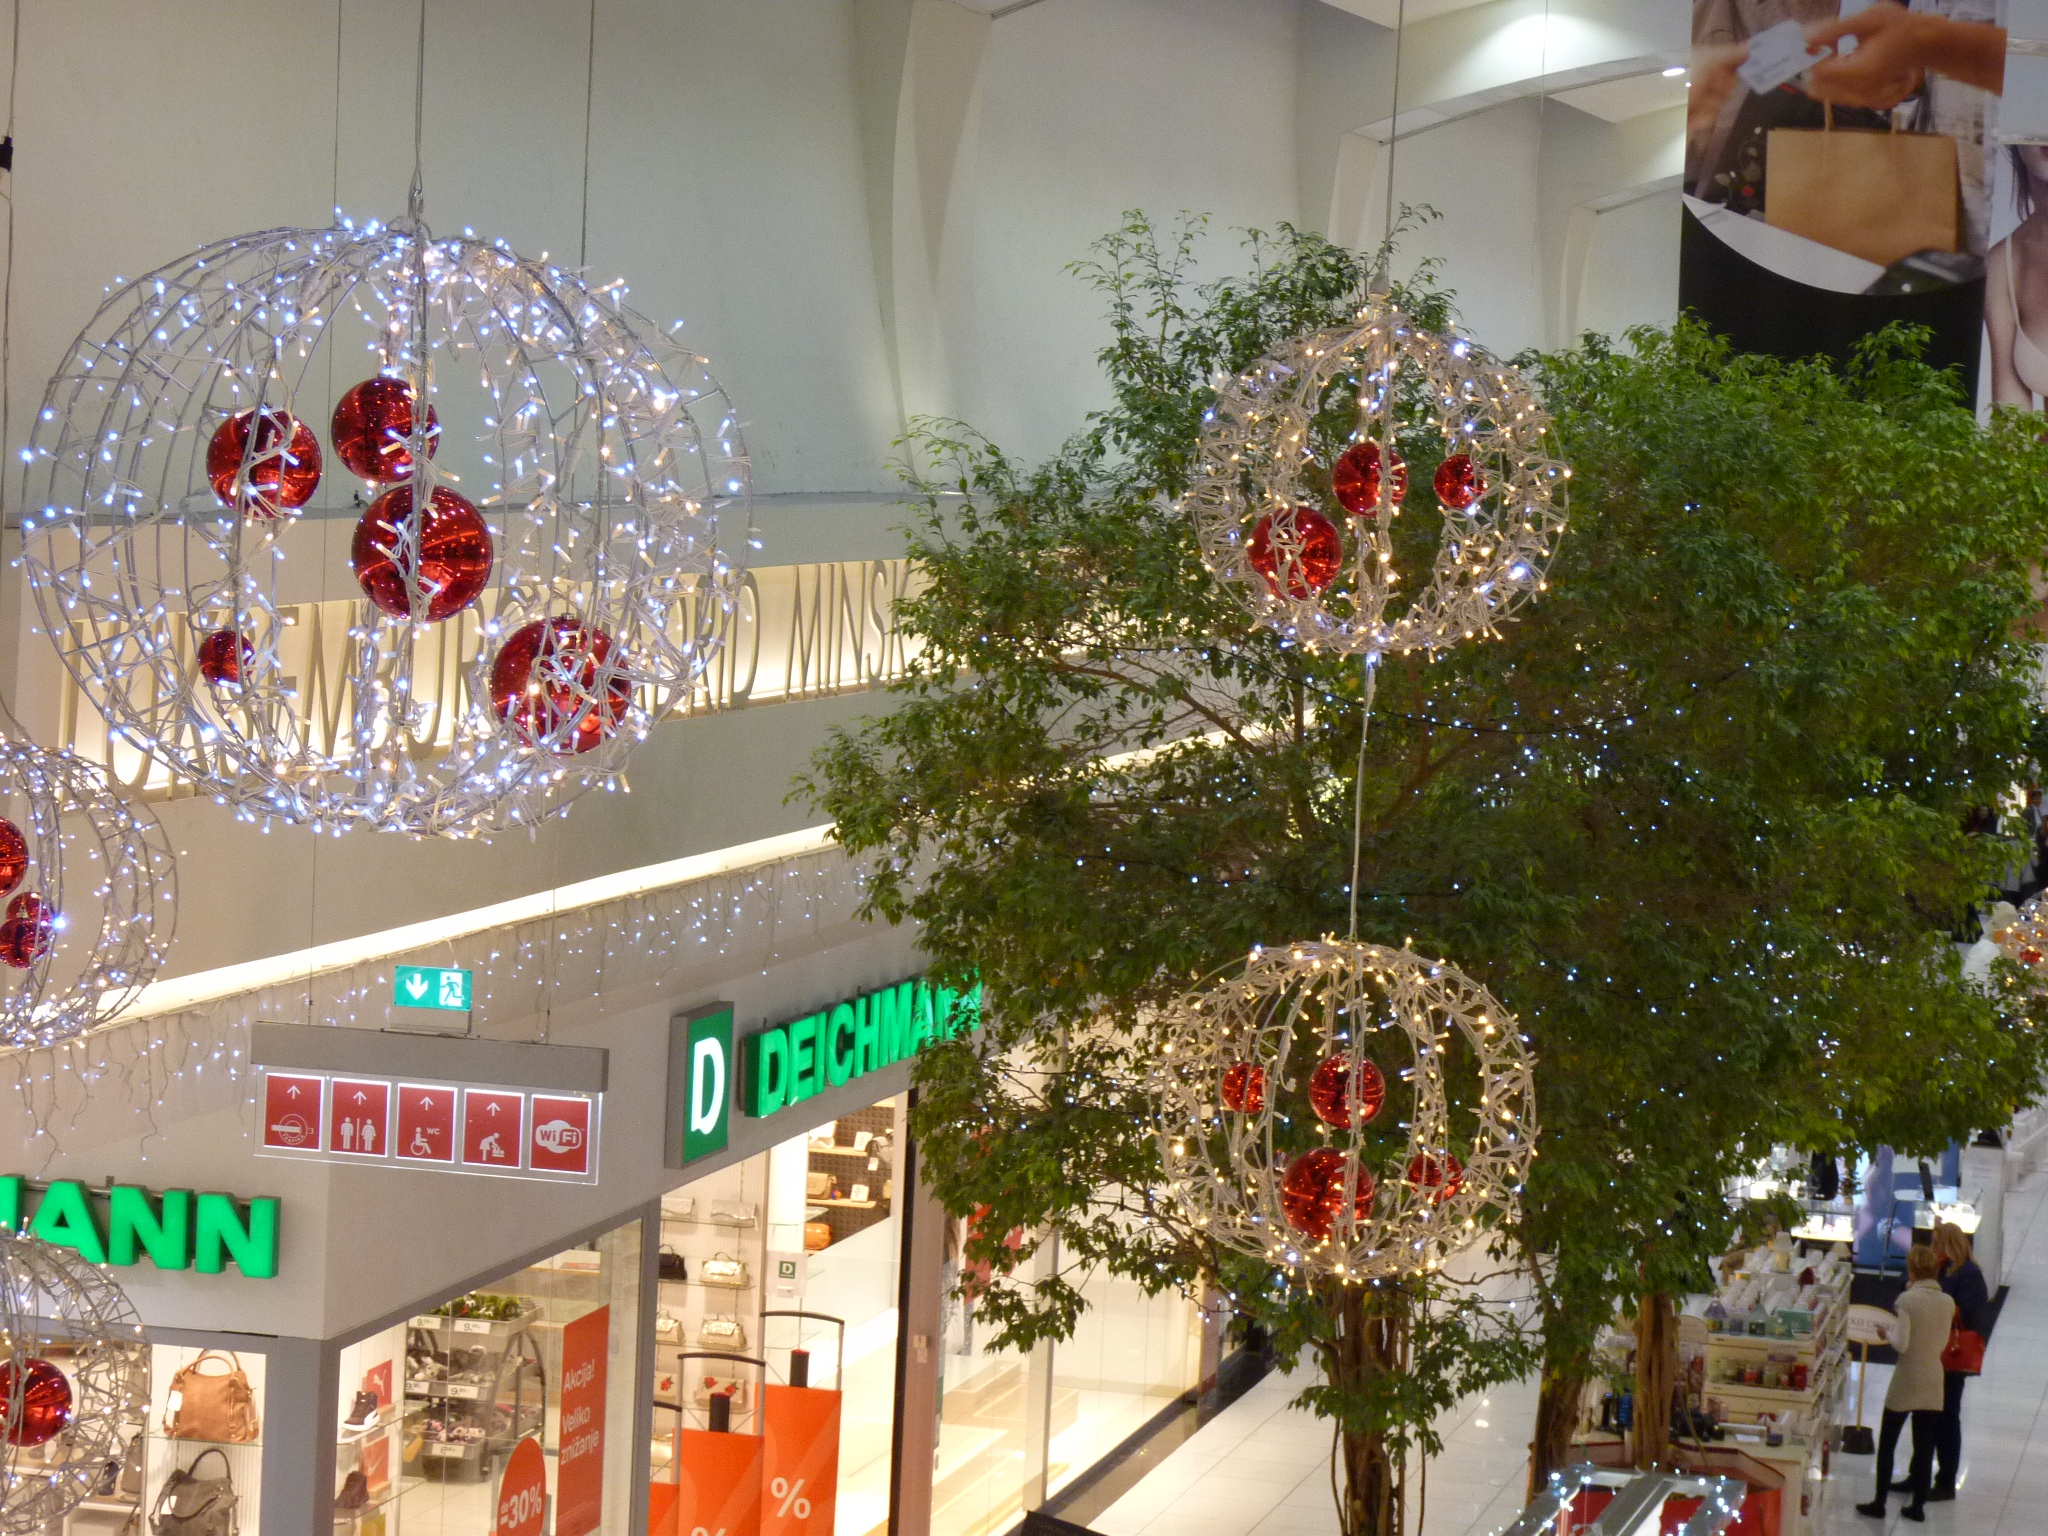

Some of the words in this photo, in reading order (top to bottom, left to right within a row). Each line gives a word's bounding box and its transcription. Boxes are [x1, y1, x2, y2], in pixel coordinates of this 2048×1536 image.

[783, 559, 913, 700] MINSK
[691, 1037, 725, 1135] D
[426, 1127, 440, 1135] WC
[0, 1174, 281, 1279] ANN
[782, 1263, 793, 1273] D
[563, 1358, 595, 1393] Akcija!
[561, 1405, 591, 1434] Veliko
[560, 1429, 599, 1465] znižanje
[500, 1481, 542, 1529] -30%
